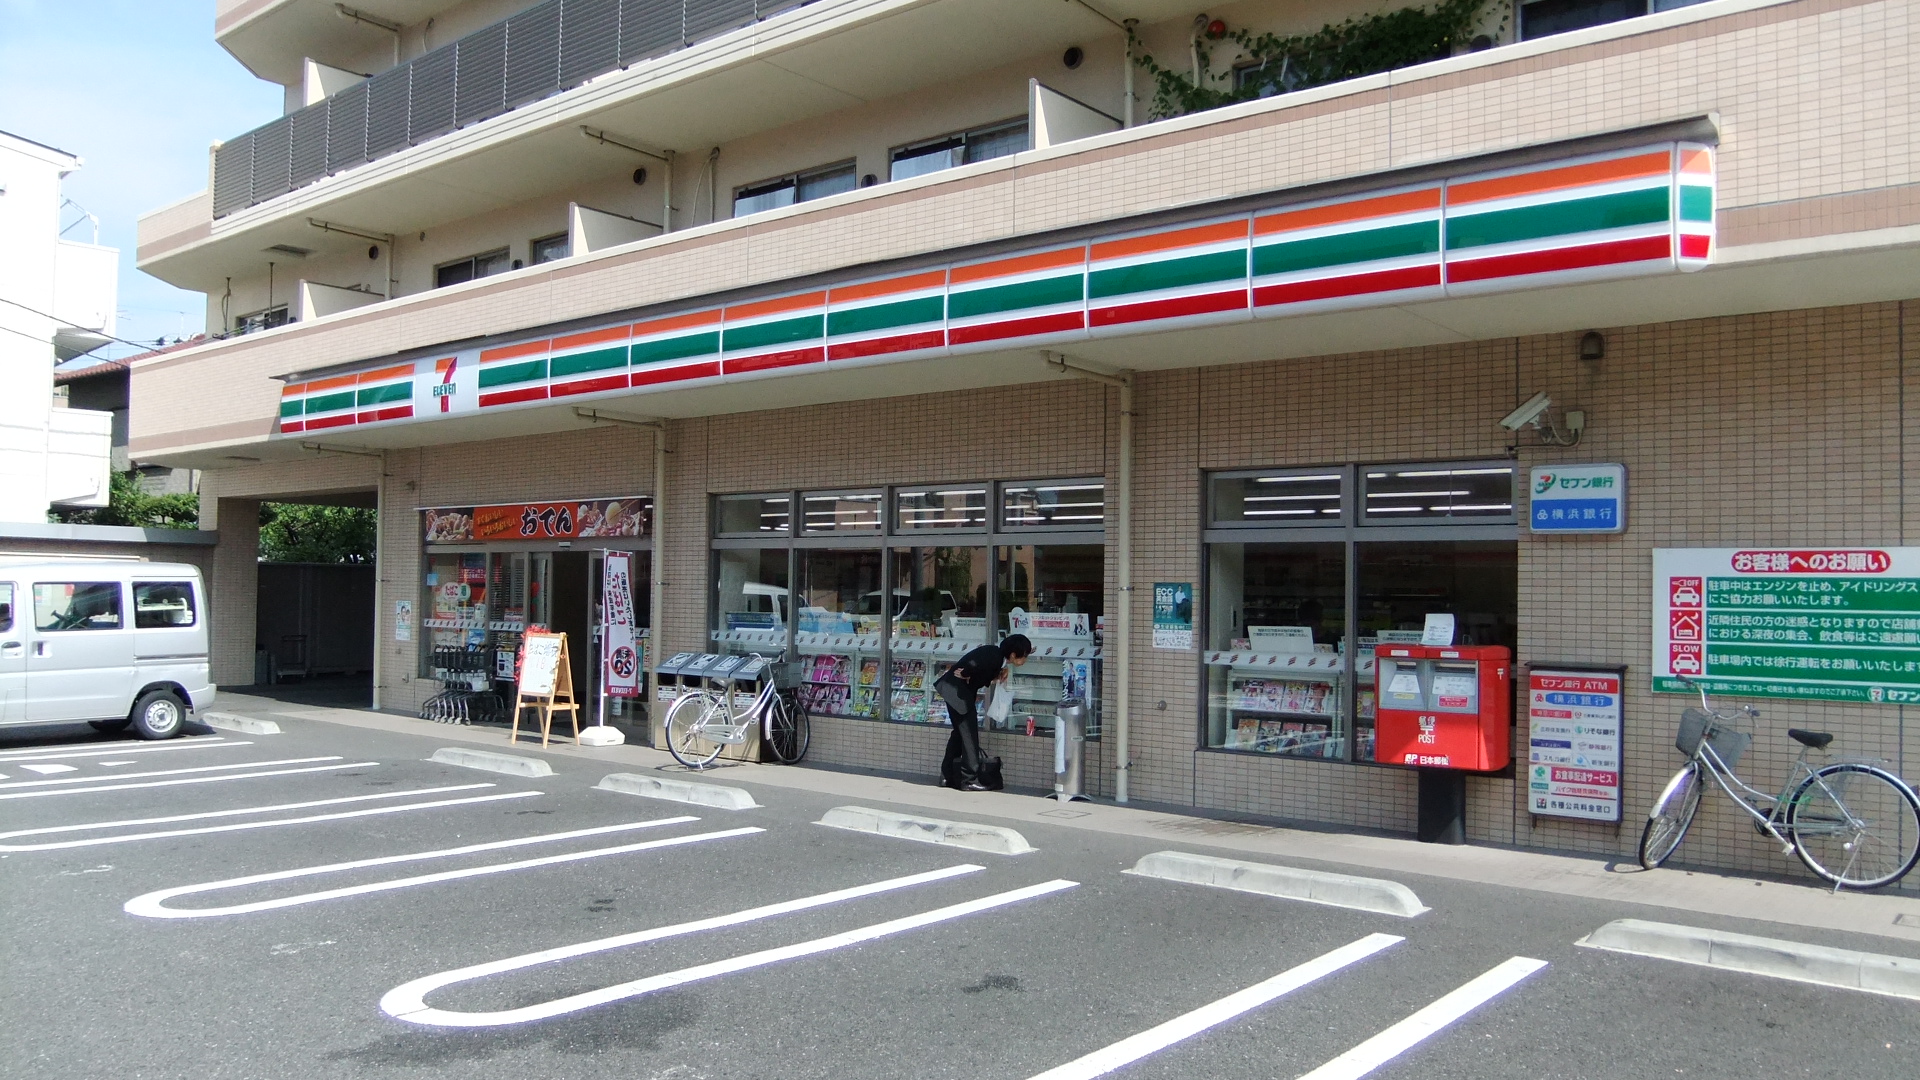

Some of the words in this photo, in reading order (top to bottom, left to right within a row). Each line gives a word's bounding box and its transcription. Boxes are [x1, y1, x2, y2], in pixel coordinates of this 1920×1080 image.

[1560, 476, 1614, 489] セブン銀行
[1552, 508, 1612, 520] 横浜銀行
[520, 506, 572, 536] おでん
[1734, 552, 1888, 571] お客様へのお願い
[1672, 645, 1699, 653] SLOW
[1541, 678, 1580, 689] セブン銀行
[1584, 681, 1608, 690] ATM
[1554, 694, 1604, 706] 横浜銀行
[1584, 727, 1616, 736] りそな銀行
[1418, 734, 1436, 744] POST
[1420, 754, 1449, 765] 日本郵便
[1551, 801, 1611, 814] 各種公共料金窓口
